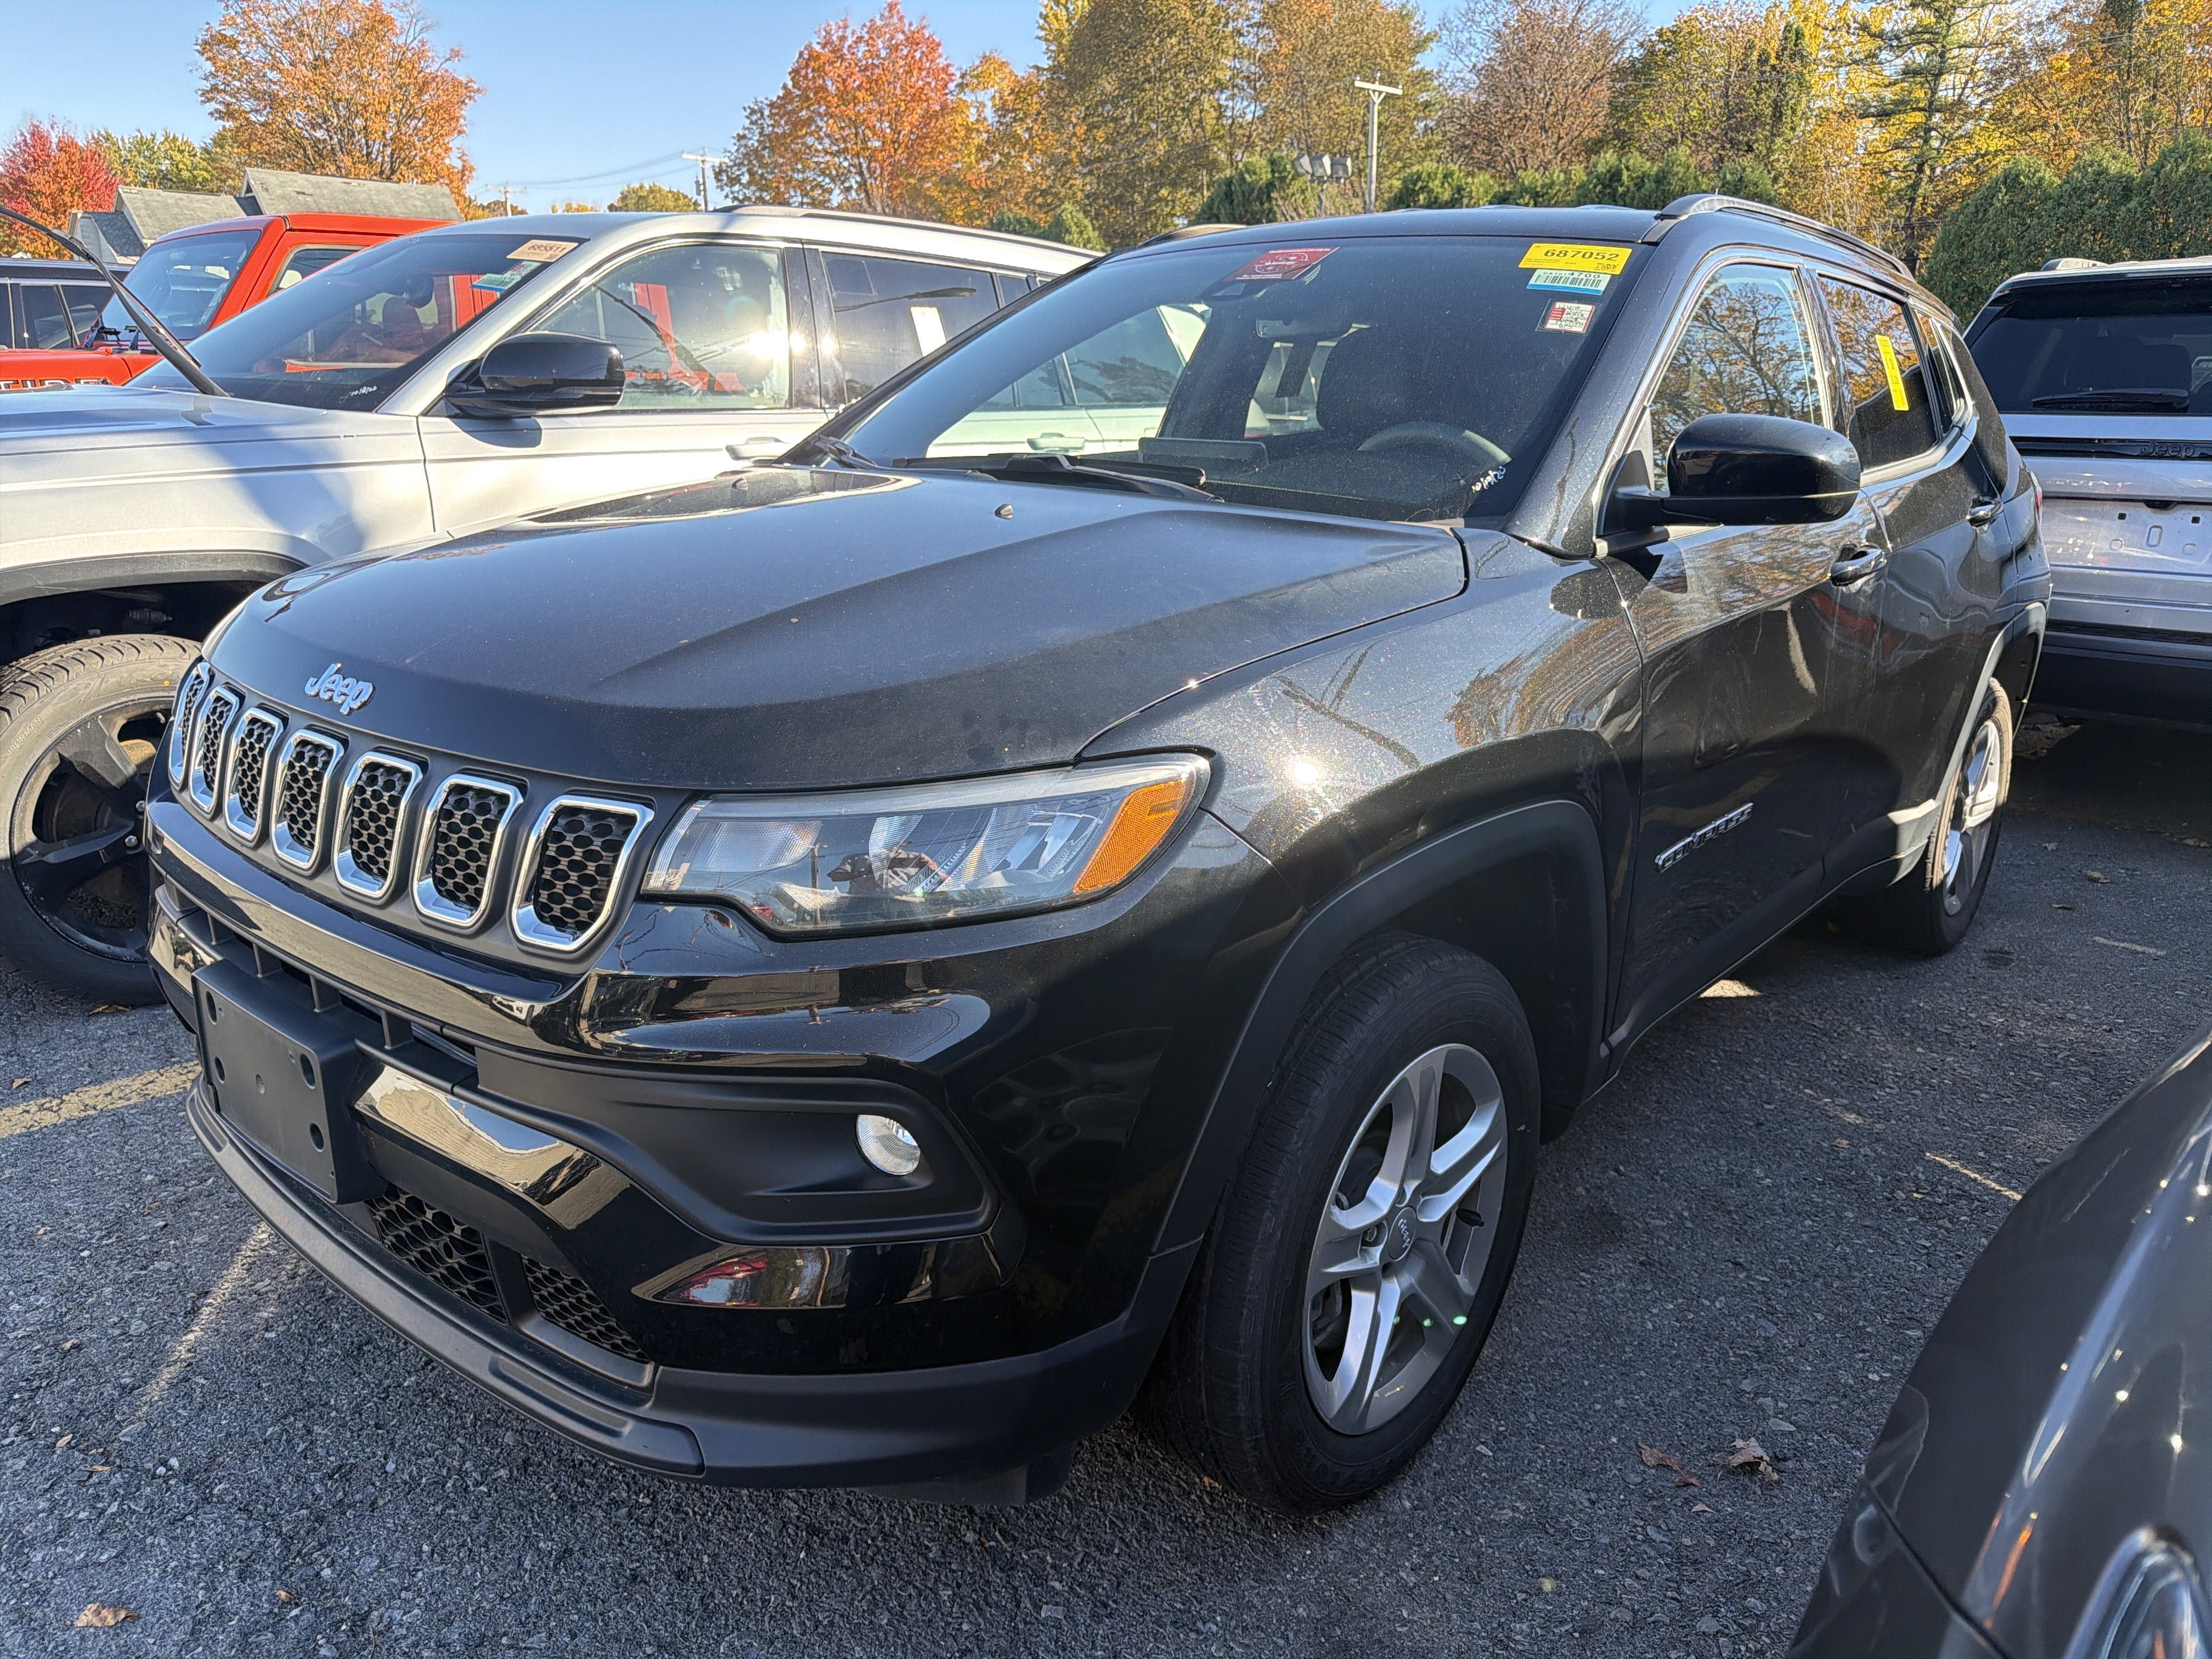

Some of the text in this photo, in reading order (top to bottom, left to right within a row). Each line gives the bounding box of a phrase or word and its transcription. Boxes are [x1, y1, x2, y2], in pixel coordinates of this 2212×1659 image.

[1544, 249, 1620, 262] 687052
[2140, 440, 2196, 460] Jeep
[304, 662, 375, 716] Jeep
